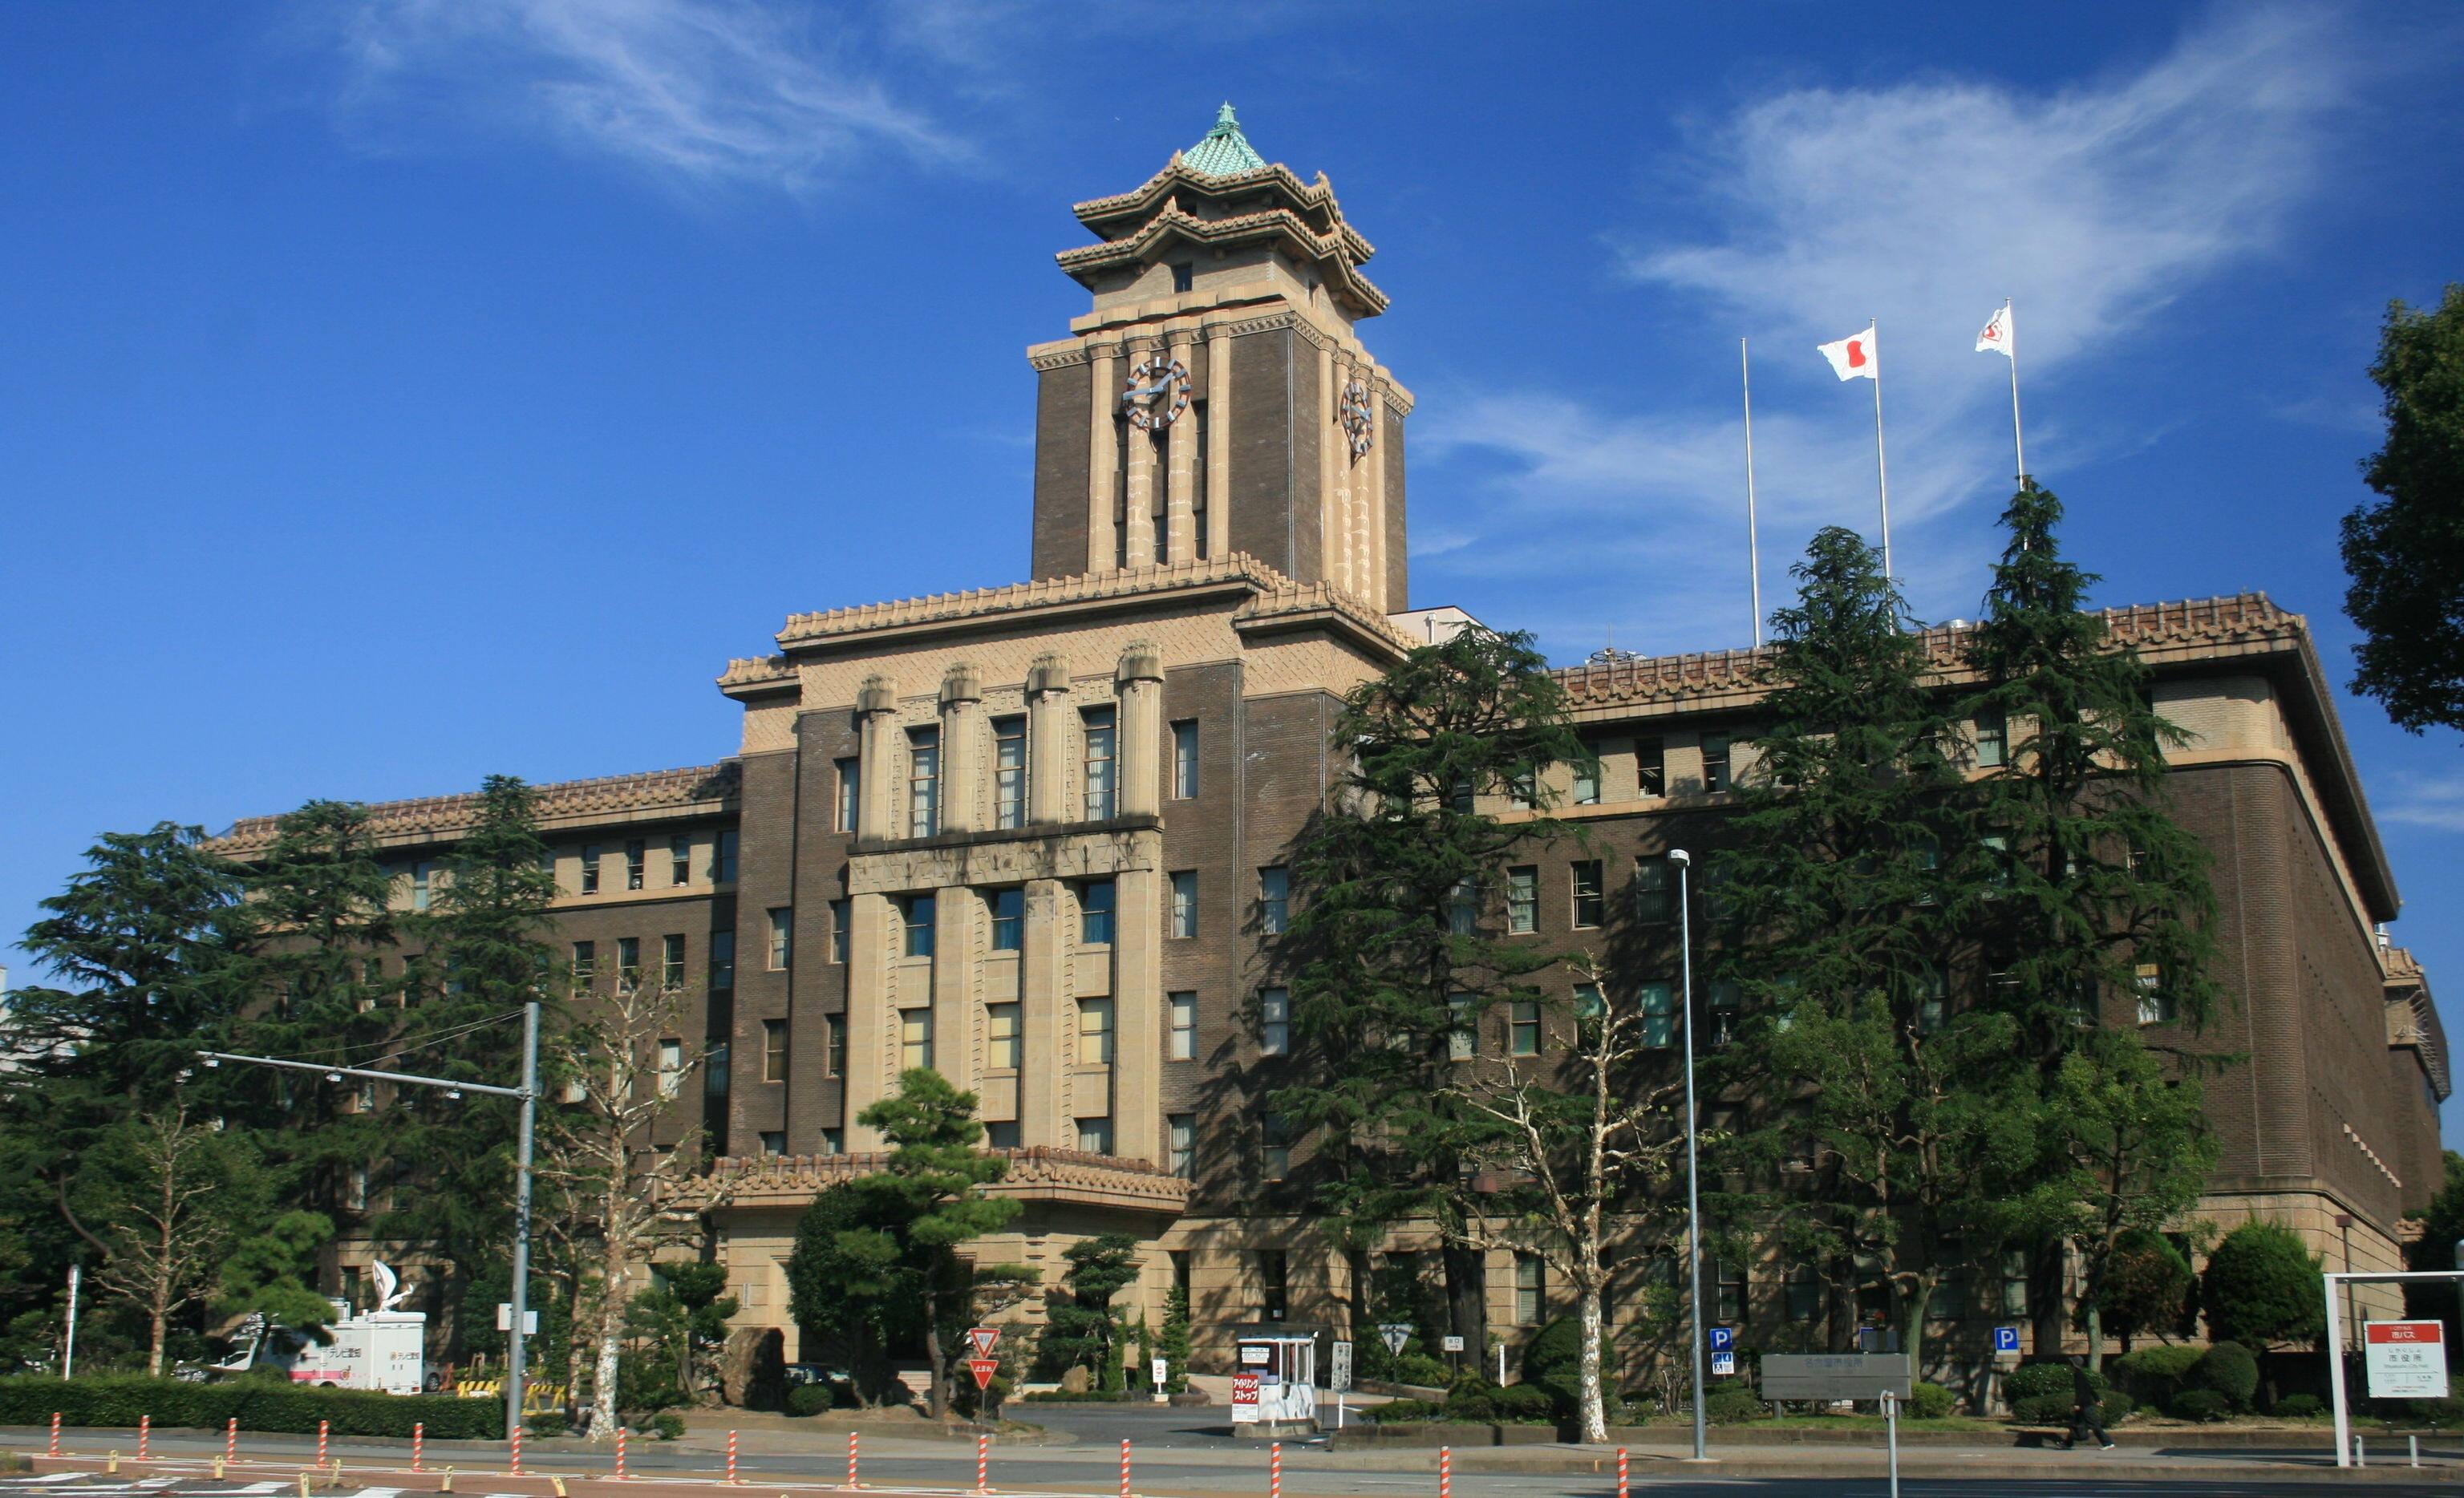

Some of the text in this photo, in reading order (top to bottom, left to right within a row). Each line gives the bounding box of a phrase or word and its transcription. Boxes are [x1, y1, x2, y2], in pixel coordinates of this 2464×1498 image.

[1716, 1331, 1728, 1347] P
[2000, 1330, 2014, 1349] P
[2391, 1331, 2416, 1339] 市バス
[329, 1348, 361, 1358] テレビ愛知
[2389, 1353, 2422, 1362] 市役所
[1234, 1379, 1258, 1389] アイドリング
[1234, 1391, 1258, 1401] ストップ
